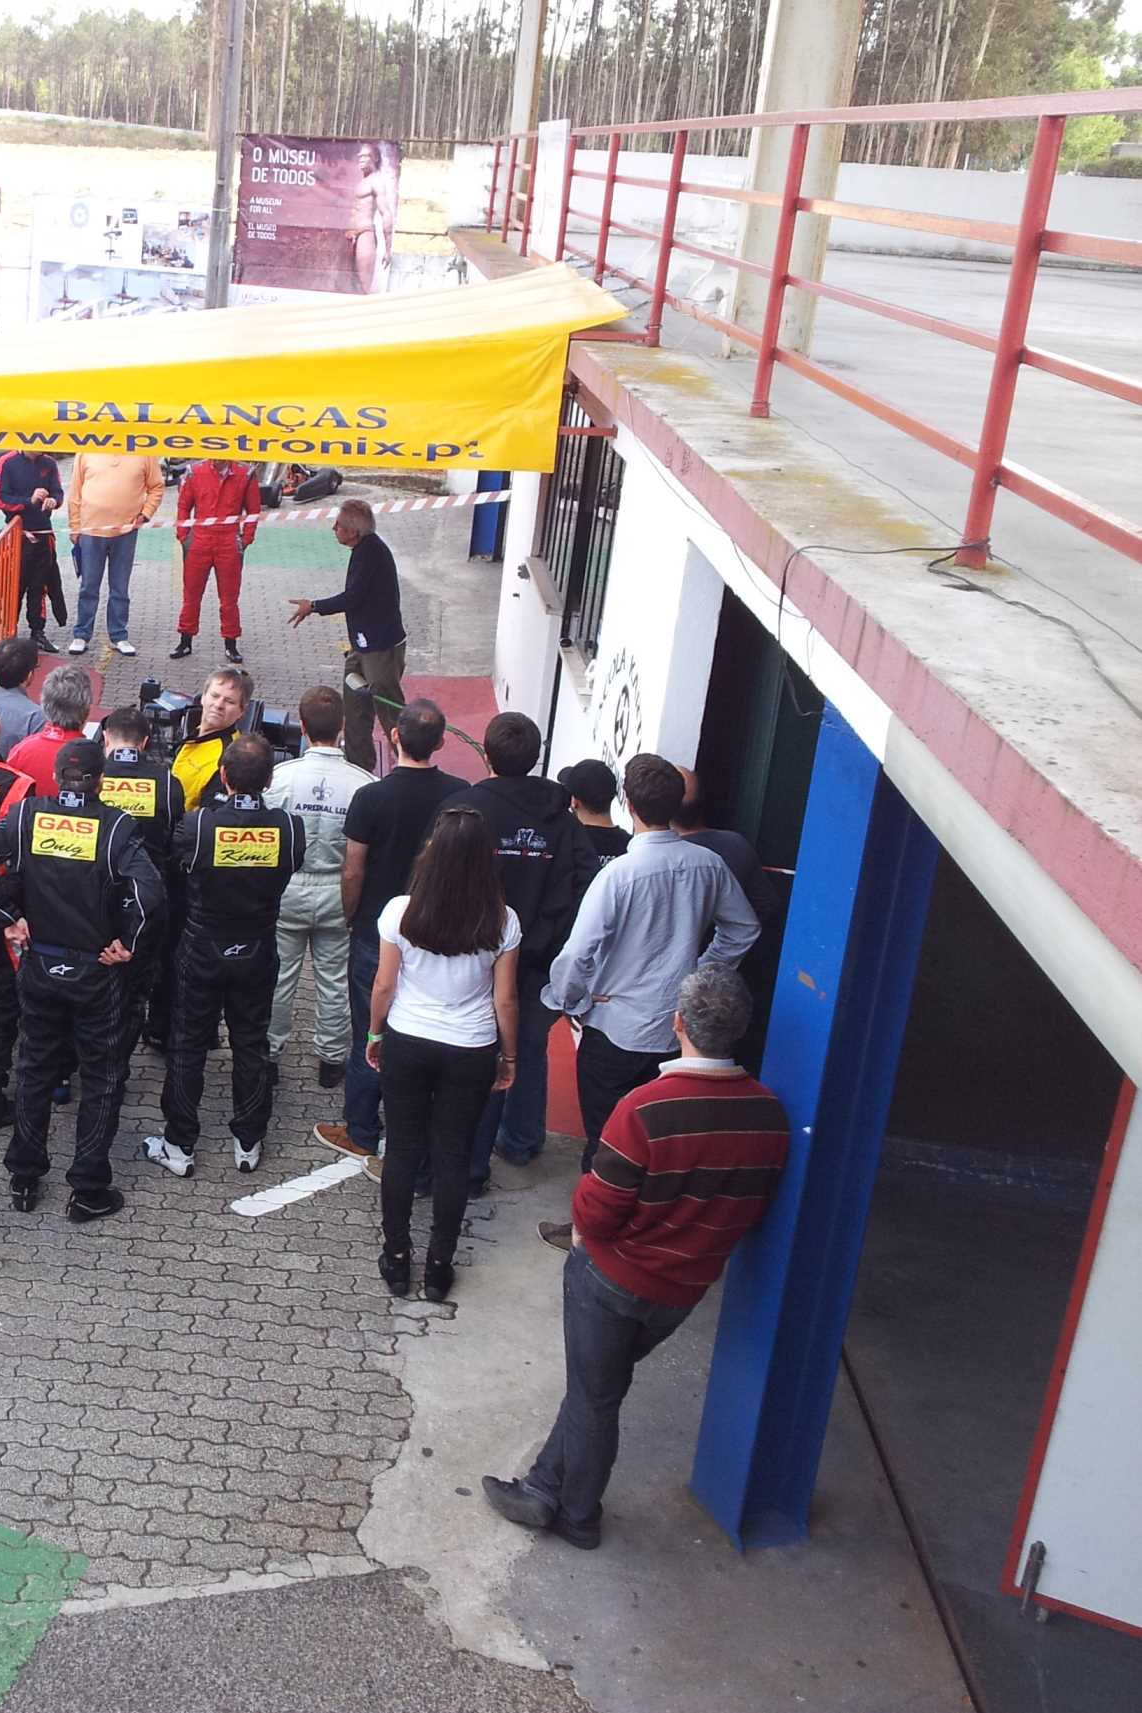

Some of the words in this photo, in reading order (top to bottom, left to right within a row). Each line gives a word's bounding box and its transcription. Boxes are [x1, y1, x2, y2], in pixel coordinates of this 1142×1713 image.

[253, 147, 262, 163] O
[269, 149, 315, 165] MUSEU
[251, 167, 268, 183] DE
[272, 168, 315, 186] TODOS
[256, 196, 283, 206] MUSEUM
[249, 205, 261, 213] FOR
[262, 206, 273, 214] ALL
[53, 400, 387, 433] BALANÇAS
[101, 780, 152, 793] GAS
[295, 803, 302, 811] A
[335, 807, 347, 815] LIZ
[37, 816, 94, 835] GAS
[219, 831, 276, 843] GAS
